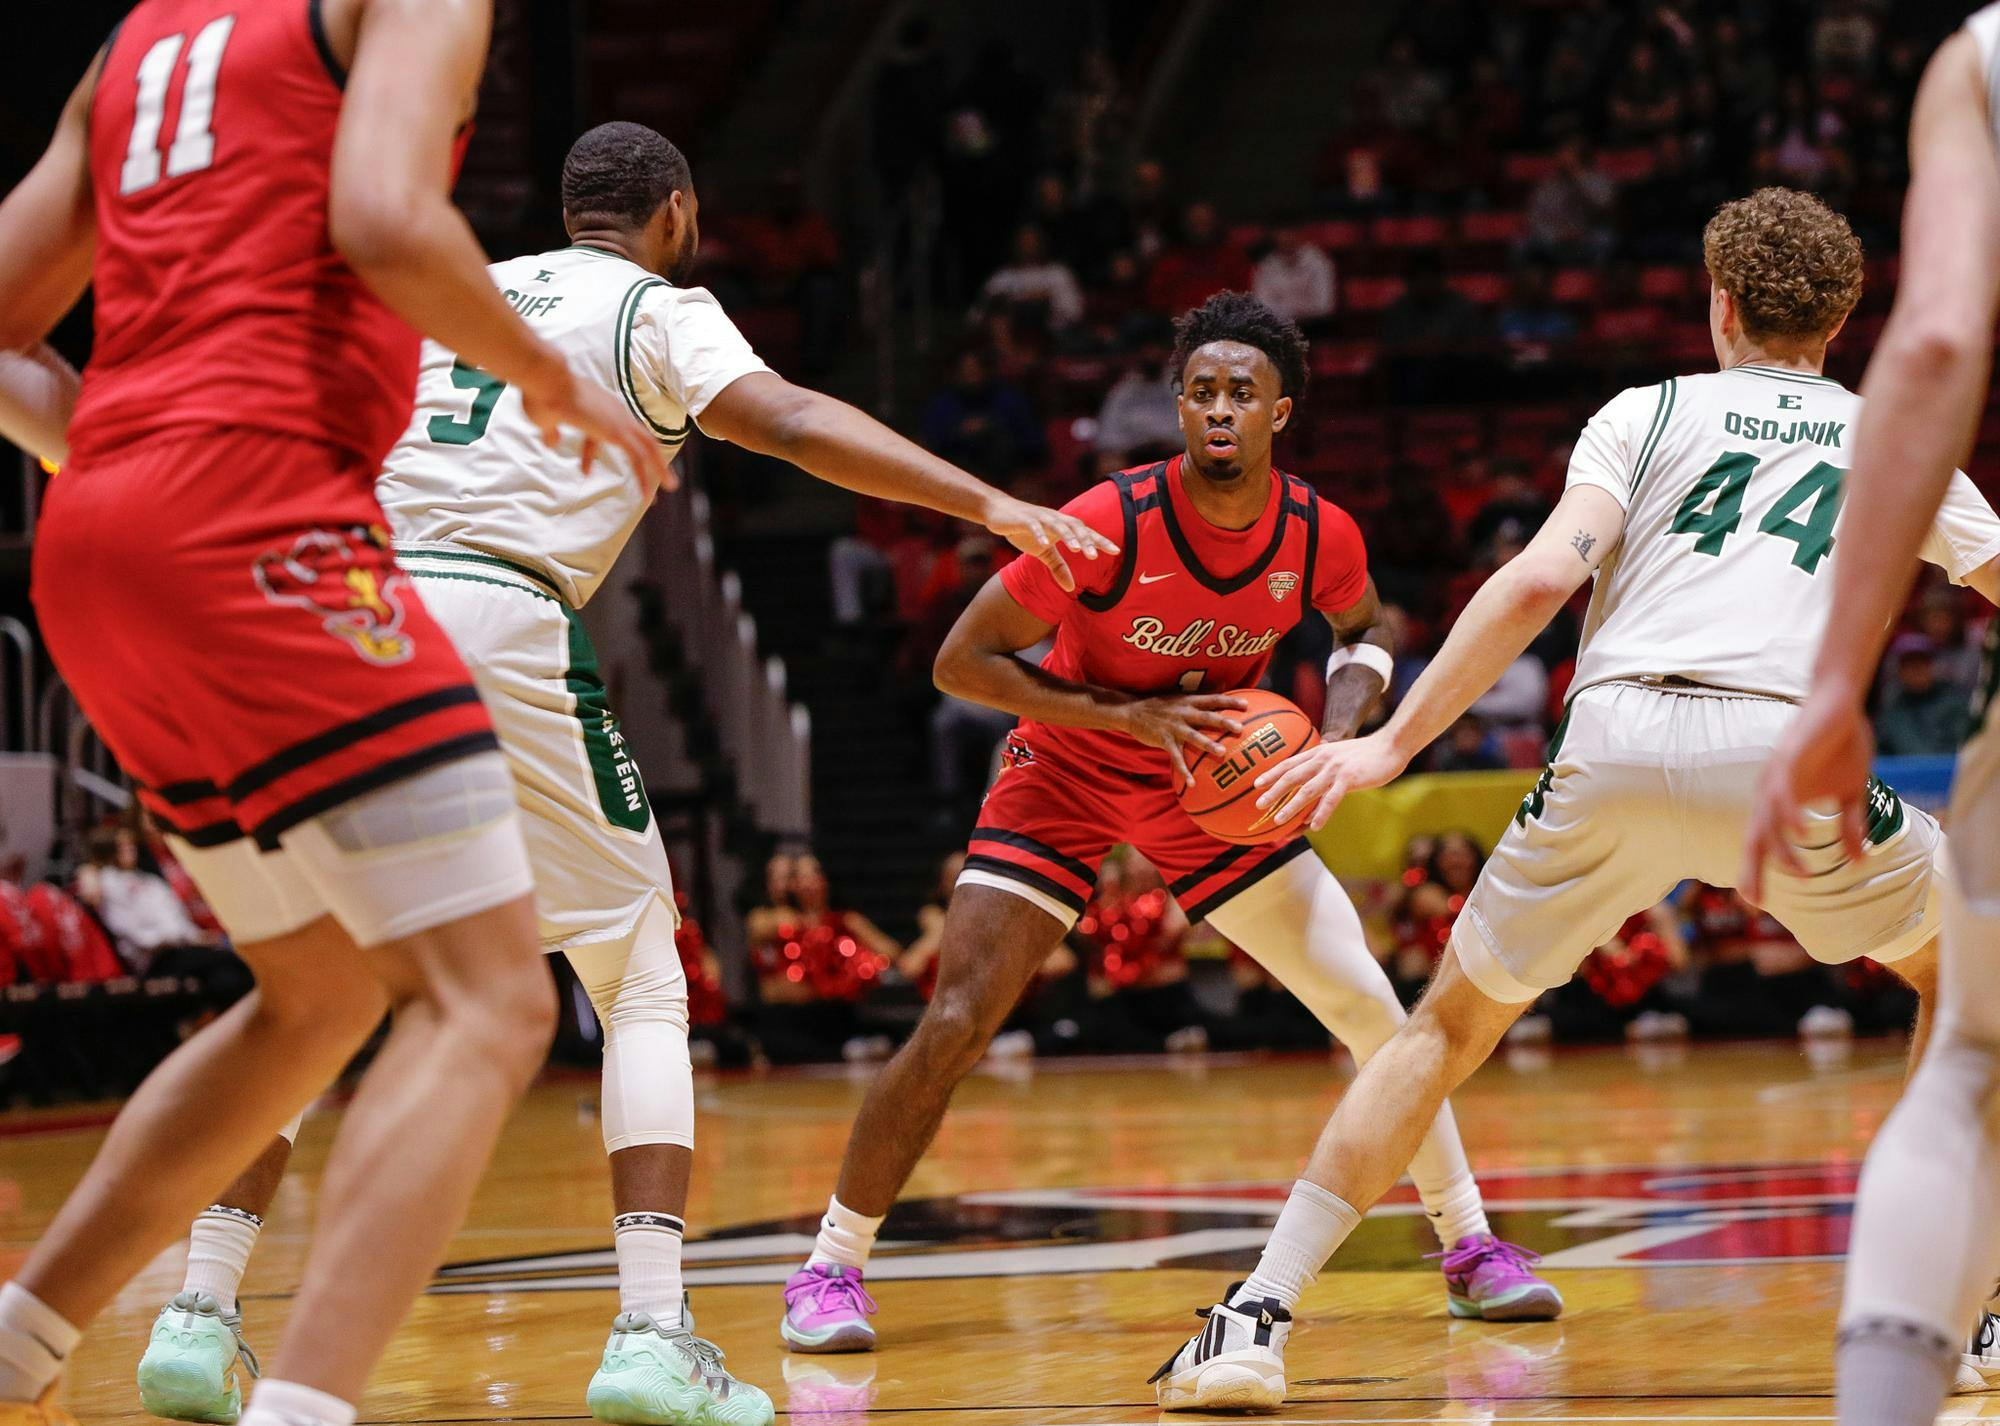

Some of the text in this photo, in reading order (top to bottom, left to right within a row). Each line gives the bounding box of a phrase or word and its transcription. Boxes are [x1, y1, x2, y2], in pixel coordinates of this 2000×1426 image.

[118, 13, 236, 197] 11
[1776, 394, 1803, 410] E
[1724, 411, 1847, 448] OSOJNIK
[1663, 450, 1850, 577] 44
[1122, 615, 1217, 658] Ball
[1210, 727, 1287, 791] ELITE
